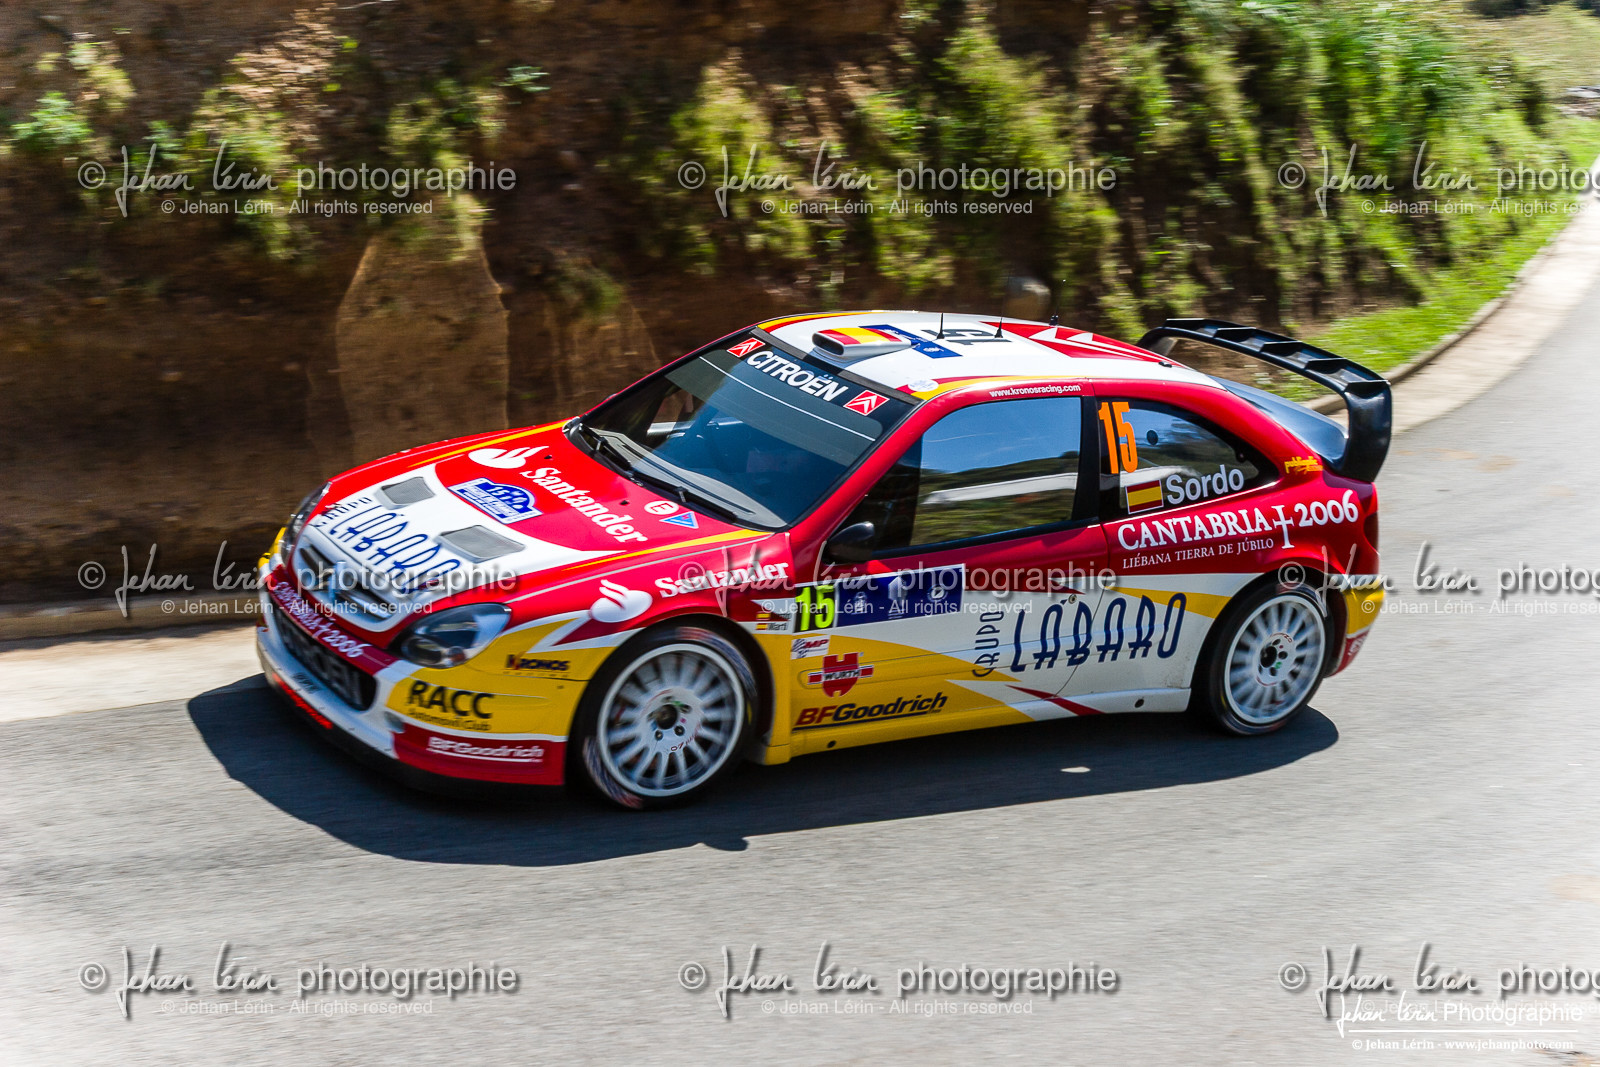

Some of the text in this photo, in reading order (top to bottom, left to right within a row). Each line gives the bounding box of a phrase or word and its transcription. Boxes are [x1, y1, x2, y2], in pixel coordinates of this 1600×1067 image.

[746, 349, 849, 402] CITROËN
[989, 382, 1081, 398] www.kronosracing.com
[1098, 401, 1139, 475] 15
[519, 466, 648, 543] Santander
[1165, 464, 1245, 505] Sordo
[1117, 490, 1359, 550] CANTABRIA 2006
[1122, 536, 1274, 569] LIÉBANA TIERRA DE JÚBILO
[654, 561, 789, 598] Santander
[795, 584, 836, 633] 15
[322, 629, 373, 658] 2006
[972, 611, 1004, 678] GRUPO
[1010, 592, 1187, 673] LÁBARO
[407, 679, 495, 719] RACC
[796, 691, 949, 726] BFGoodrich
[428, 736, 545, 757] BFGoodrich
